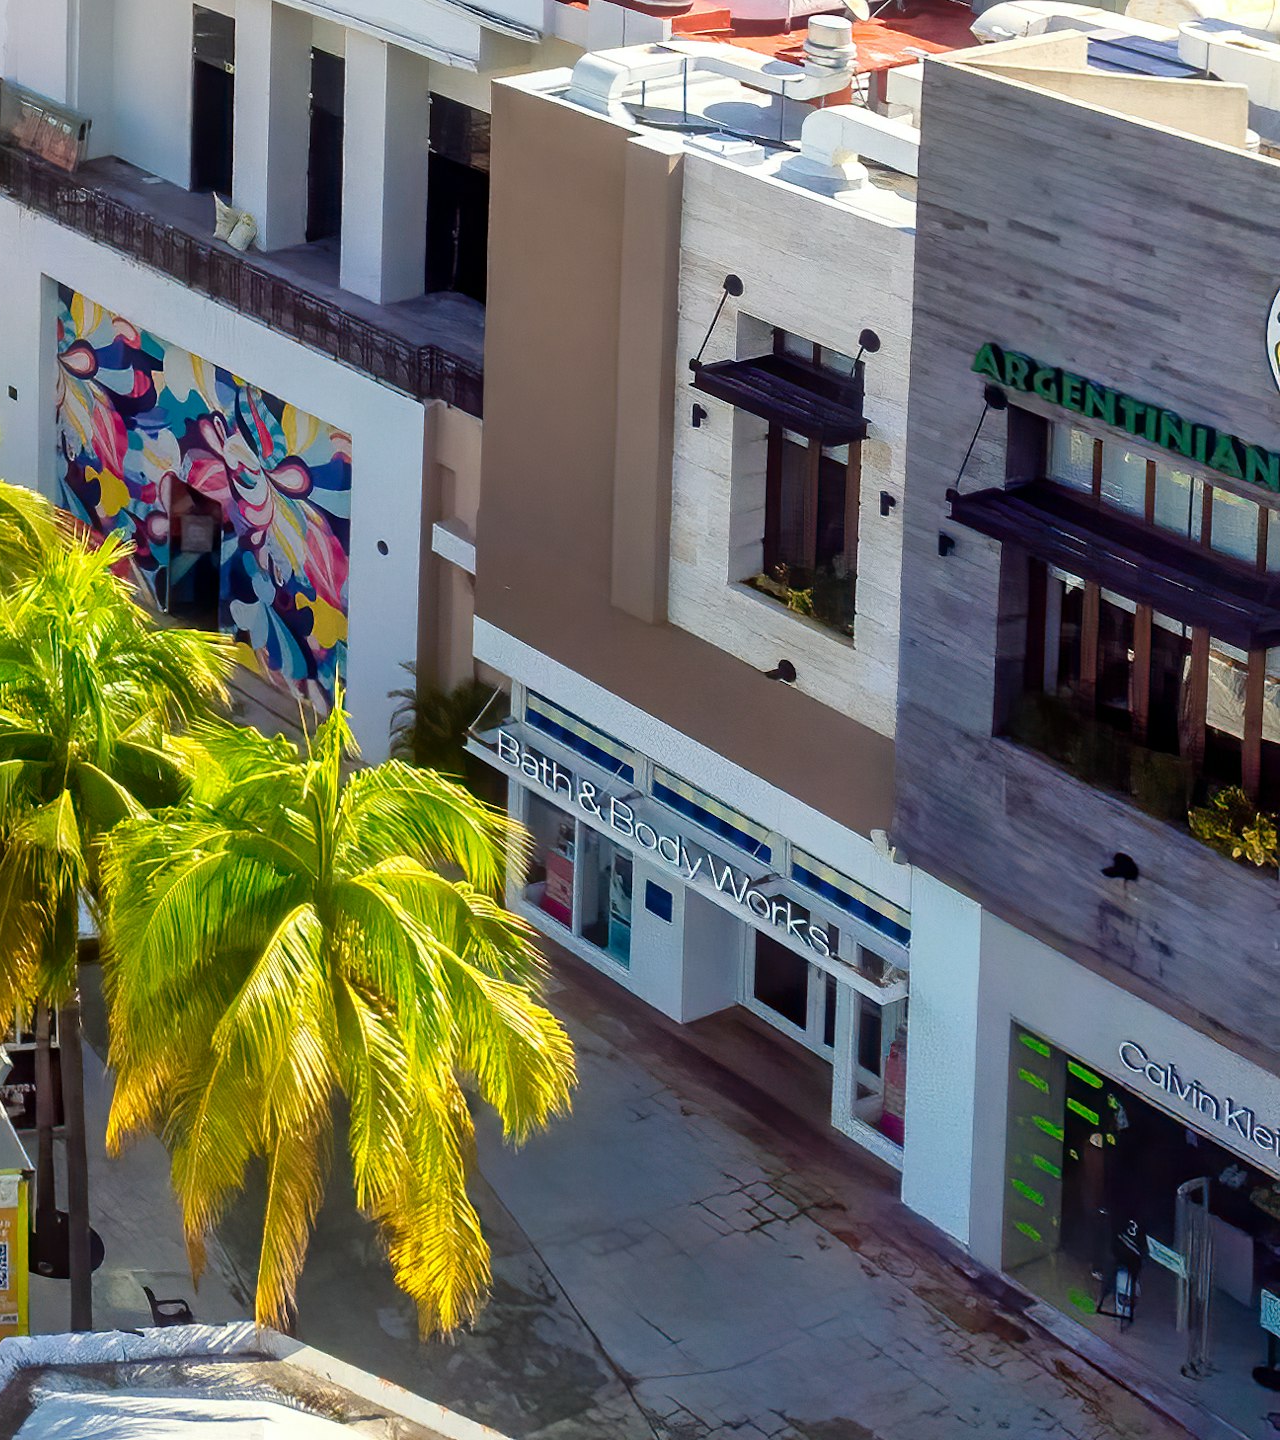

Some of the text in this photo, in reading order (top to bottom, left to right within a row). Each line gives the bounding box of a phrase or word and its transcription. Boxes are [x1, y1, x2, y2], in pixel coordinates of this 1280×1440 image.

[497, 729, 831, 957] Bath & Body Works
[1118, 1040, 1280, 1158] Calvin Klei
